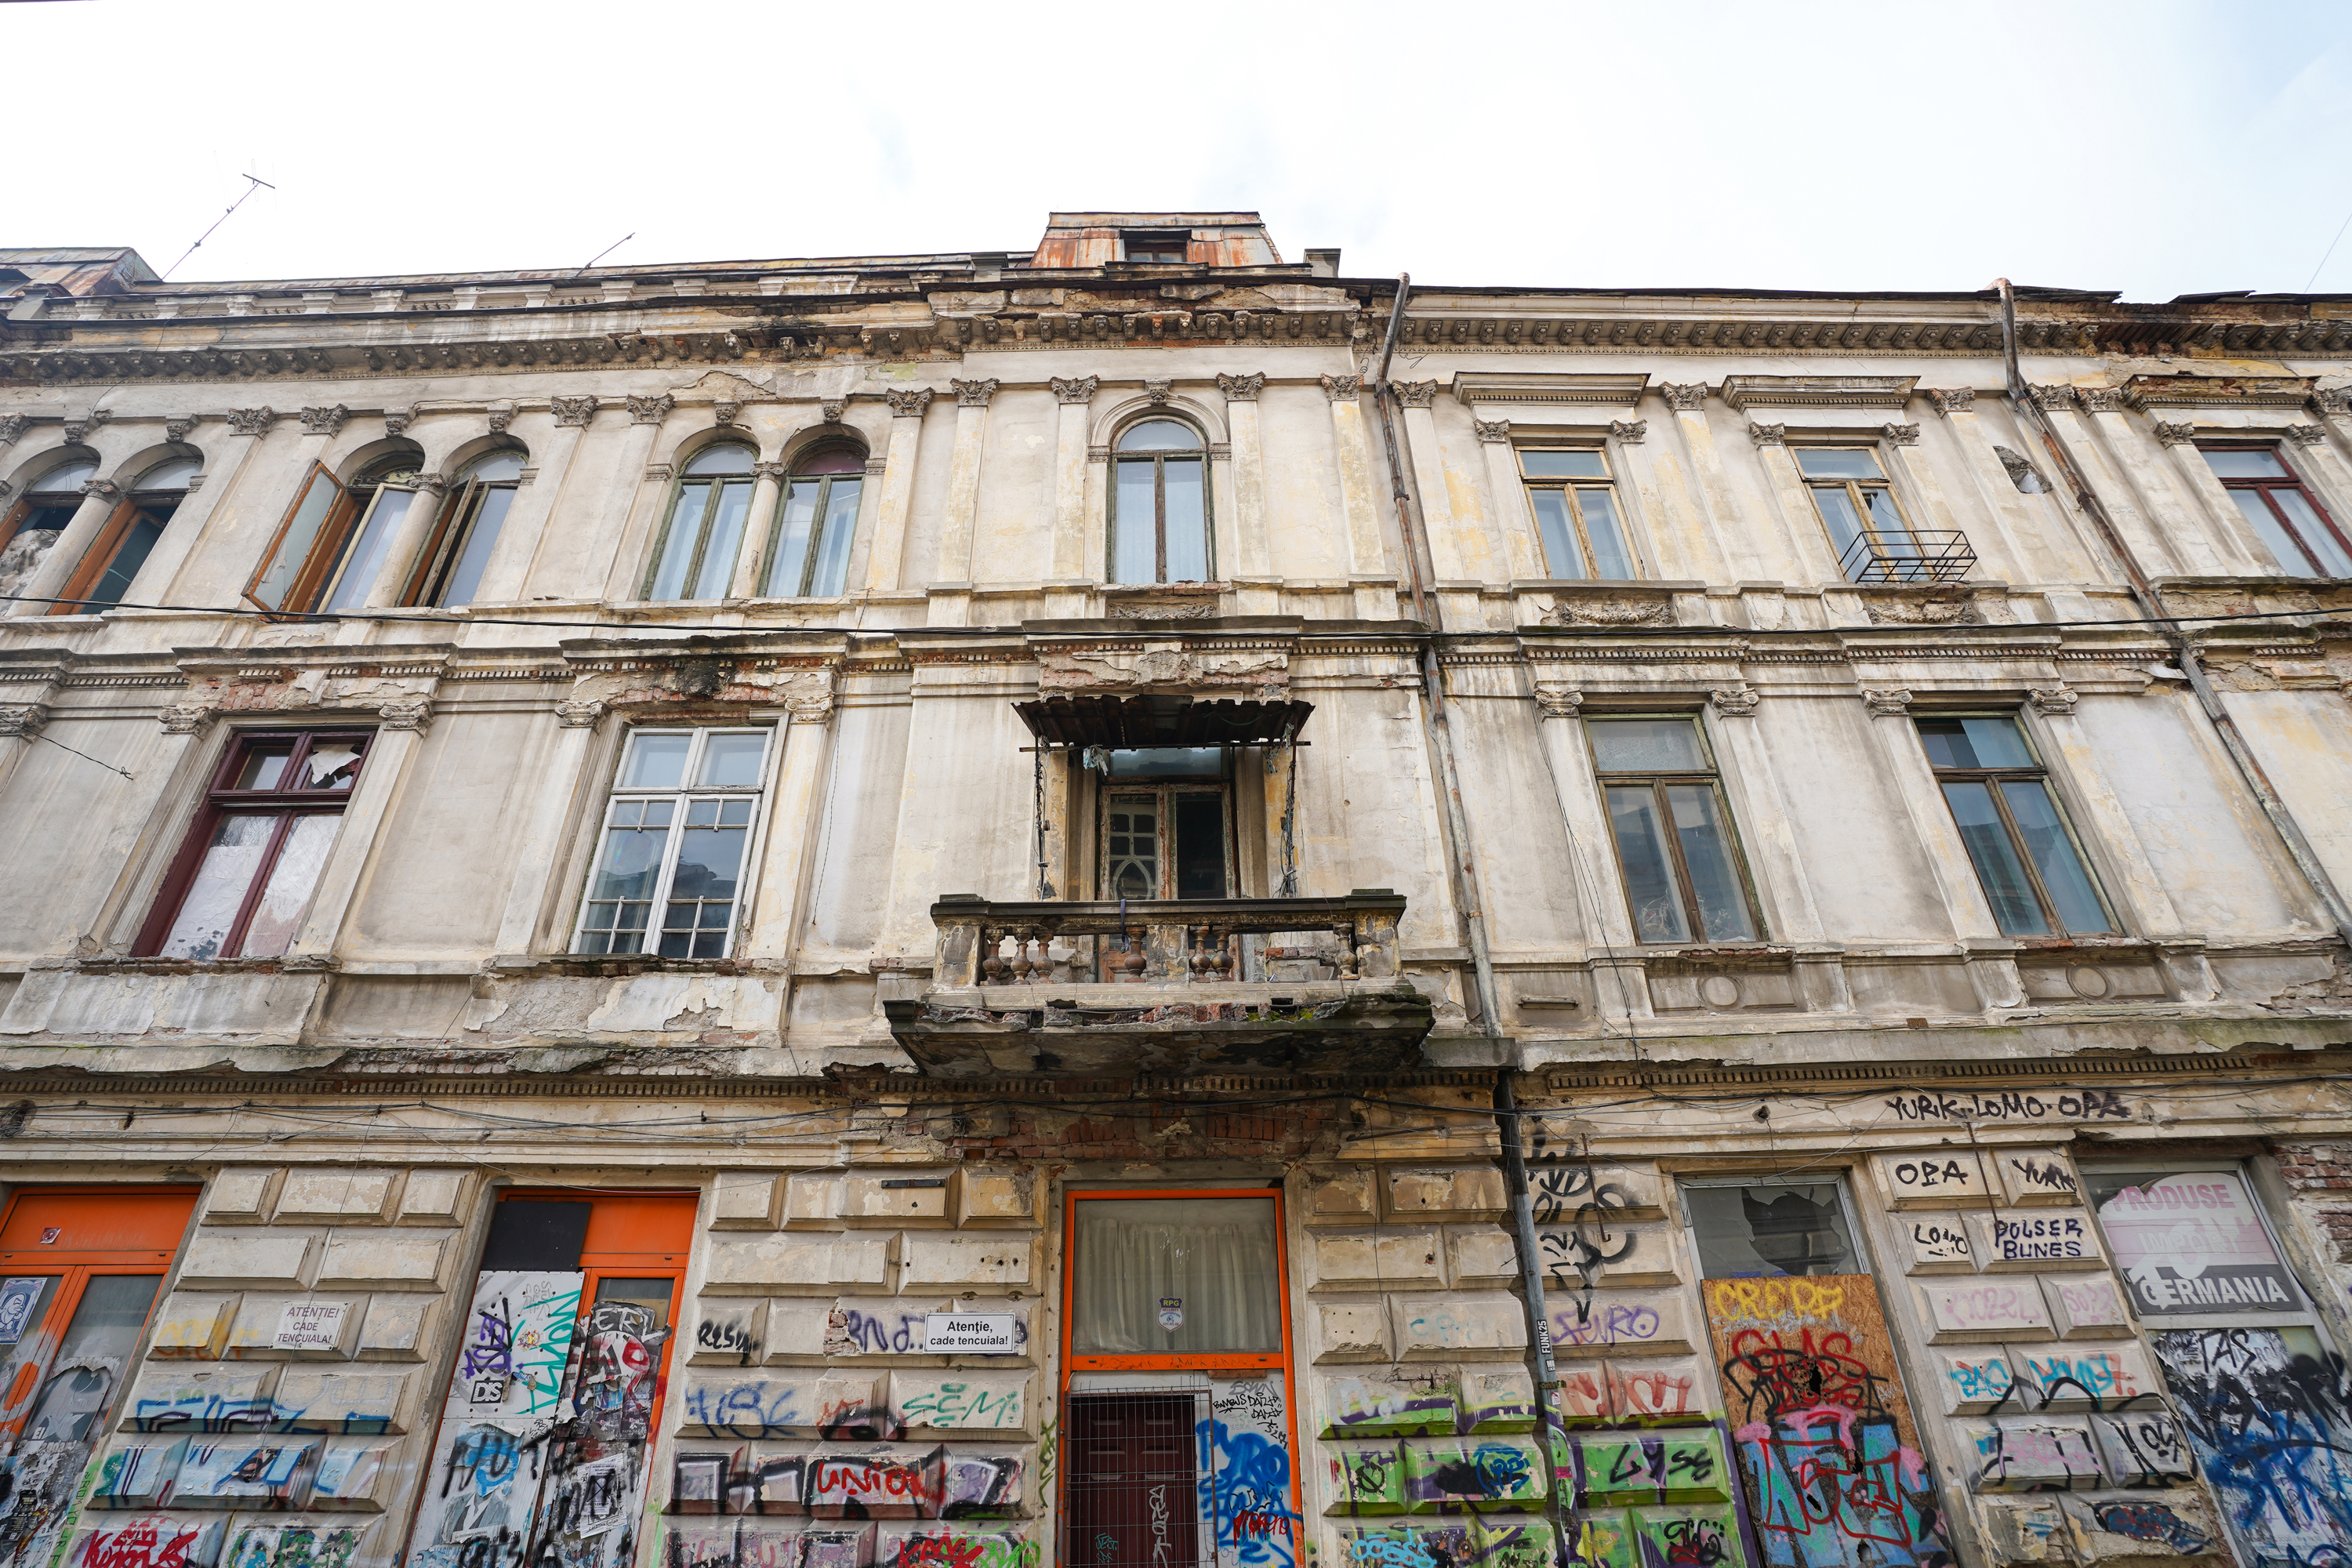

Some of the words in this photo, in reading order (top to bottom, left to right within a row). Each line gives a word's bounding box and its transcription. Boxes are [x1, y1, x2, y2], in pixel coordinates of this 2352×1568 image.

[1972, 1093, 2045, 1120] LOMO
[2059, 1092, 2132, 1119] OPA
[1896, 1160, 1968, 1186] OPA
[2112, 1185, 2236, 1211] PRODUSE
[2138, 1230, 2241, 1257] IMPORT
[2140, 1276, 2290, 1306] GERMANIA
[286, 1307, 339, 1321] ATENȚIE!
[278, 1334, 332, 1343] TENCUIALA!
[931, 1336, 955, 1345] cade
[958, 1336, 1008, 1345] tencuiala!
[947, 1321, 993, 1334] Atenţie,
[1538, 1320, 1552, 1354] FUNK25
[472, 1382, 503, 1402] DIS
